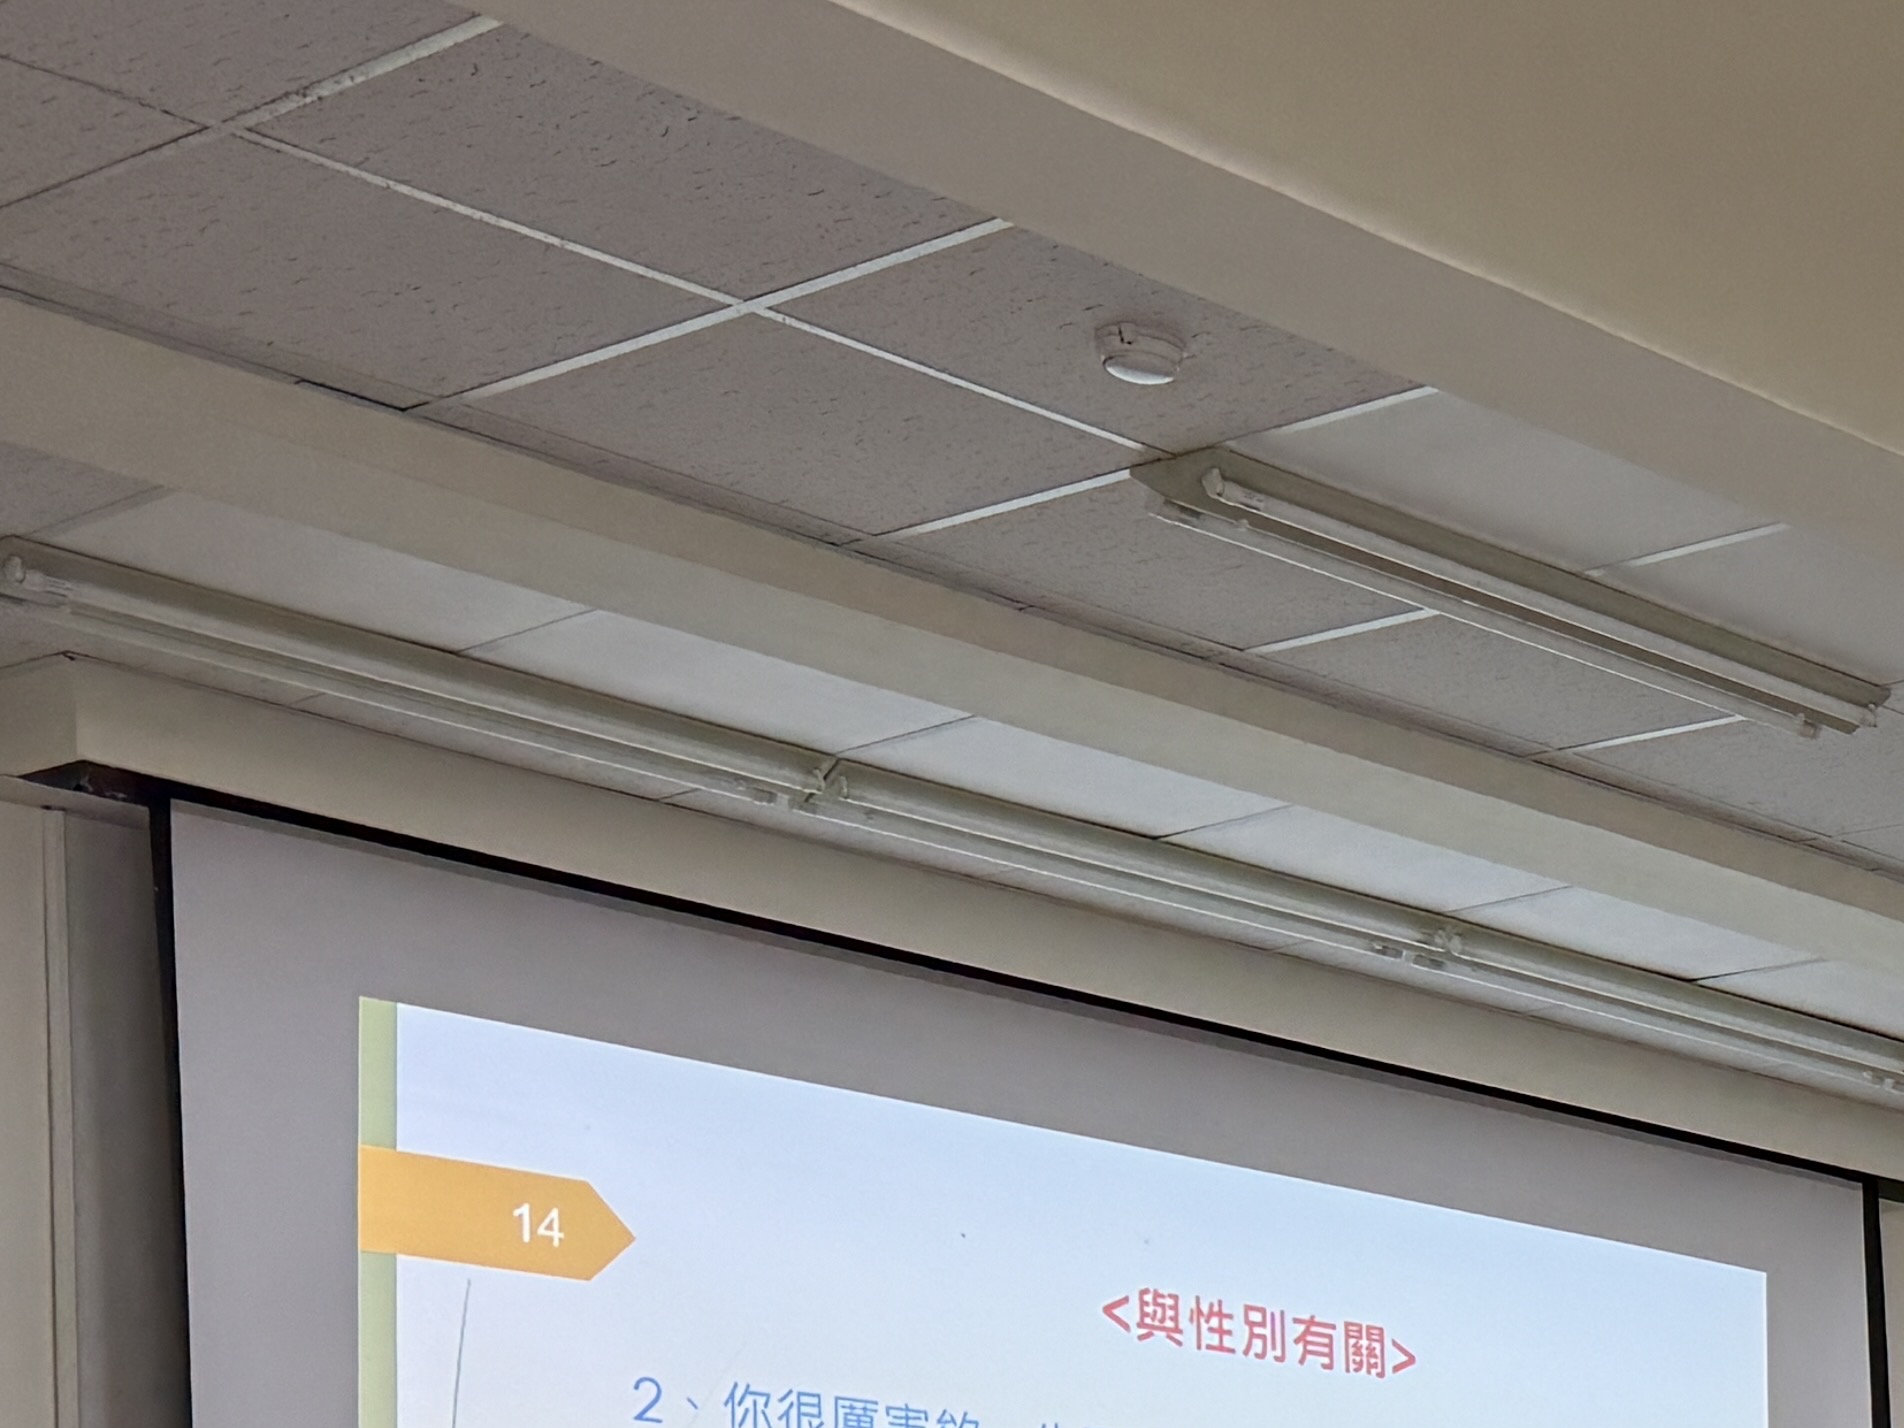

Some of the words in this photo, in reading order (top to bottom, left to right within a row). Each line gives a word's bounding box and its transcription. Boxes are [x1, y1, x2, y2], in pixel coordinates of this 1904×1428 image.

[513, 1203, 565, 1248] 14
[1102, 1287, 1416, 1379] <與性別有關>
